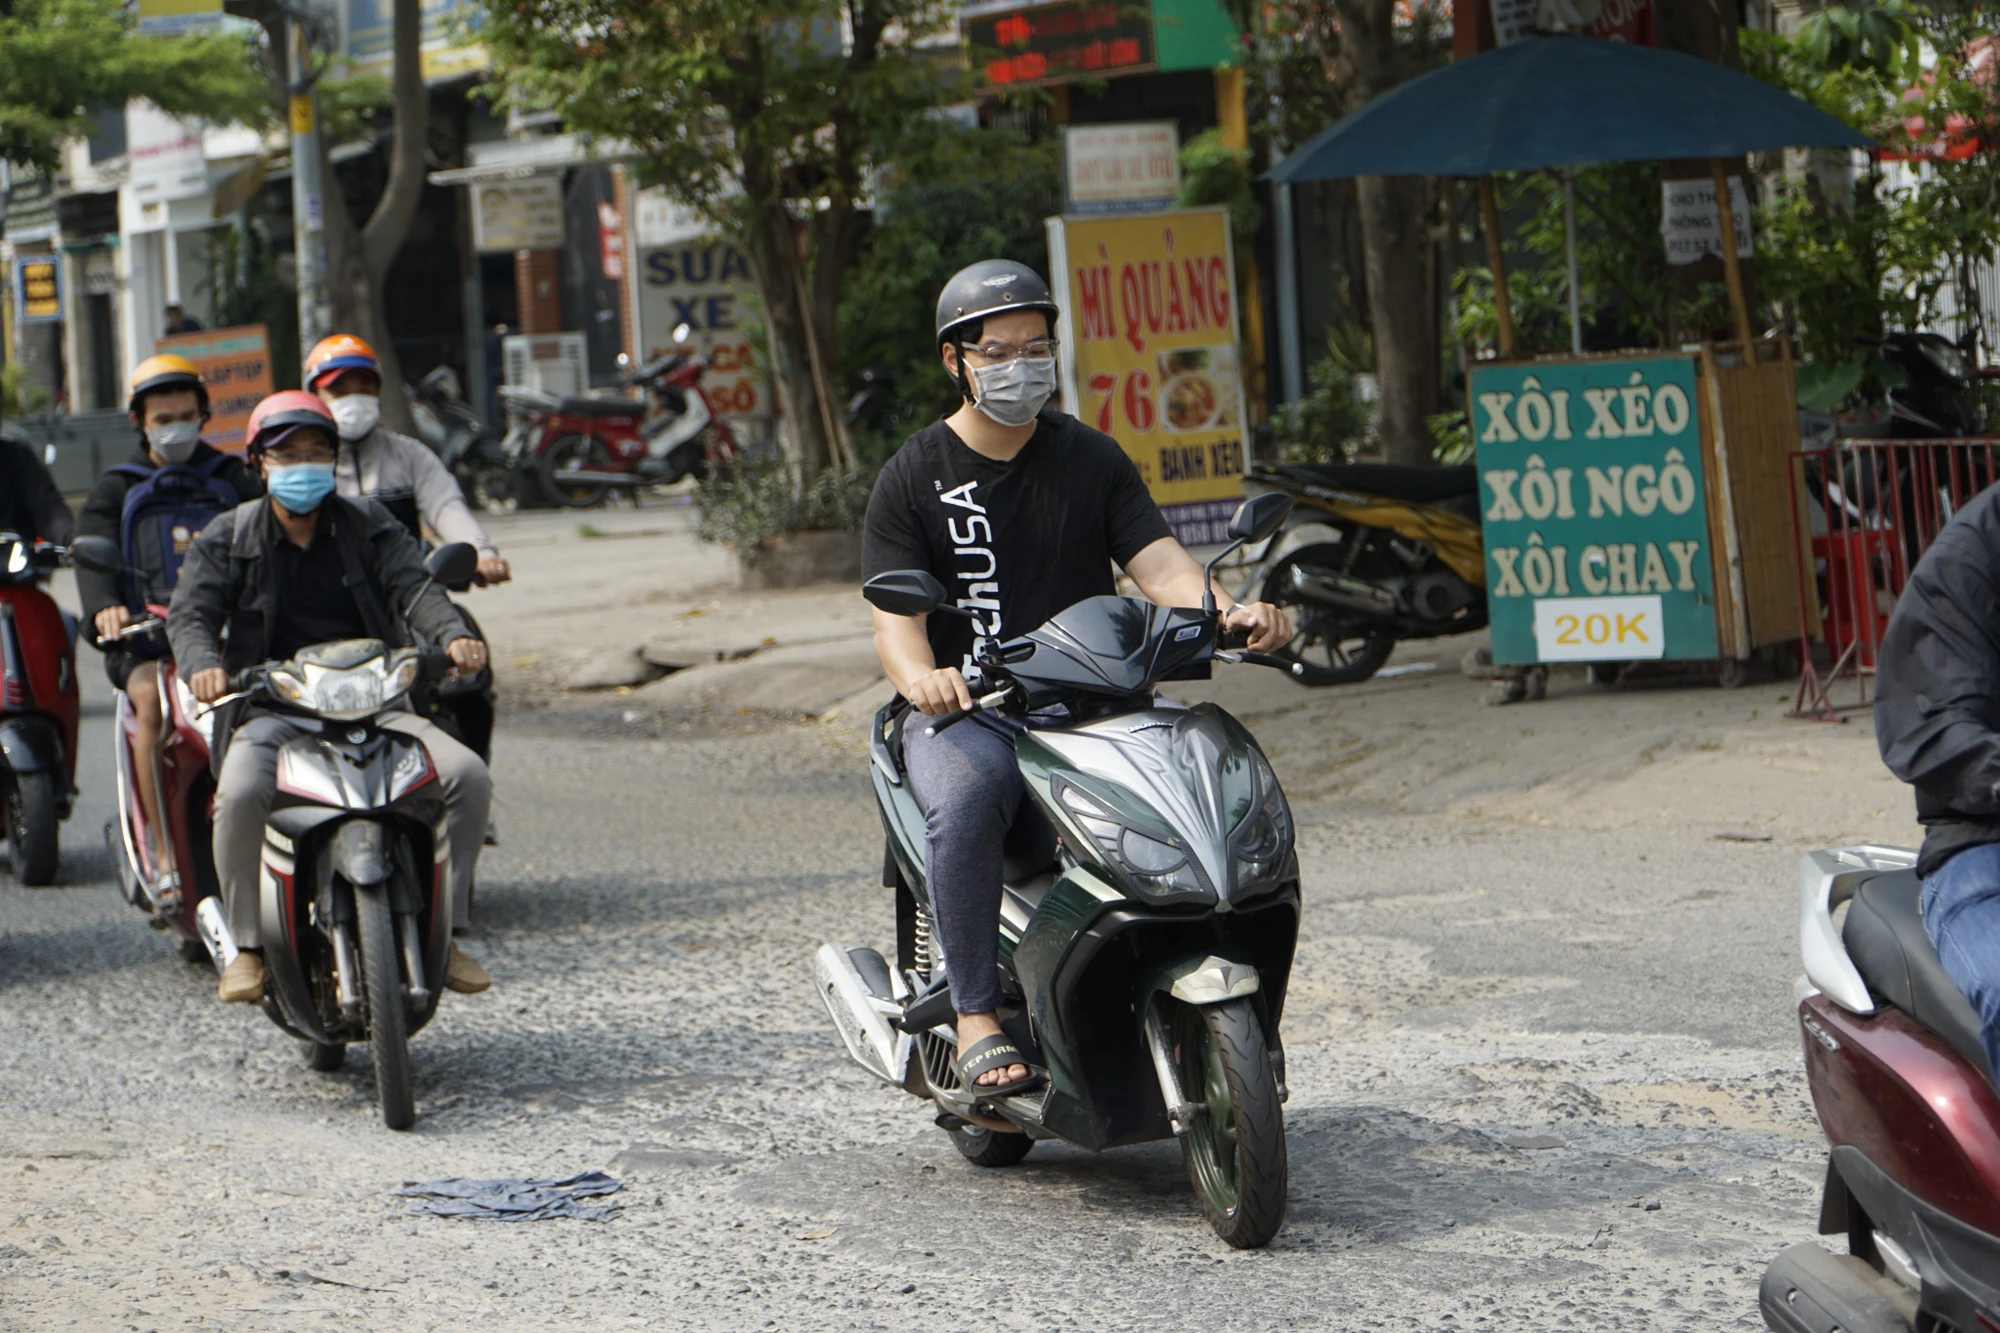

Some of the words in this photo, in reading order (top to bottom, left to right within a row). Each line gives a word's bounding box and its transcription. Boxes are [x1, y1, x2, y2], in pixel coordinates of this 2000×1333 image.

[669, 297, 739, 331] XE
[1089, 369, 1156, 434] 76
[1479, 375, 1573, 443] XÔI
[1583, 370, 1690, 439] XÉO
[1484, 453, 1576, 521] XÔI
[1585, 446, 1696, 517] NGÔ
[1491, 530, 1570, 597] XÔI
[1579, 540, 1700, 595] CHAY
[1554, 612, 1650, 645] 20K
